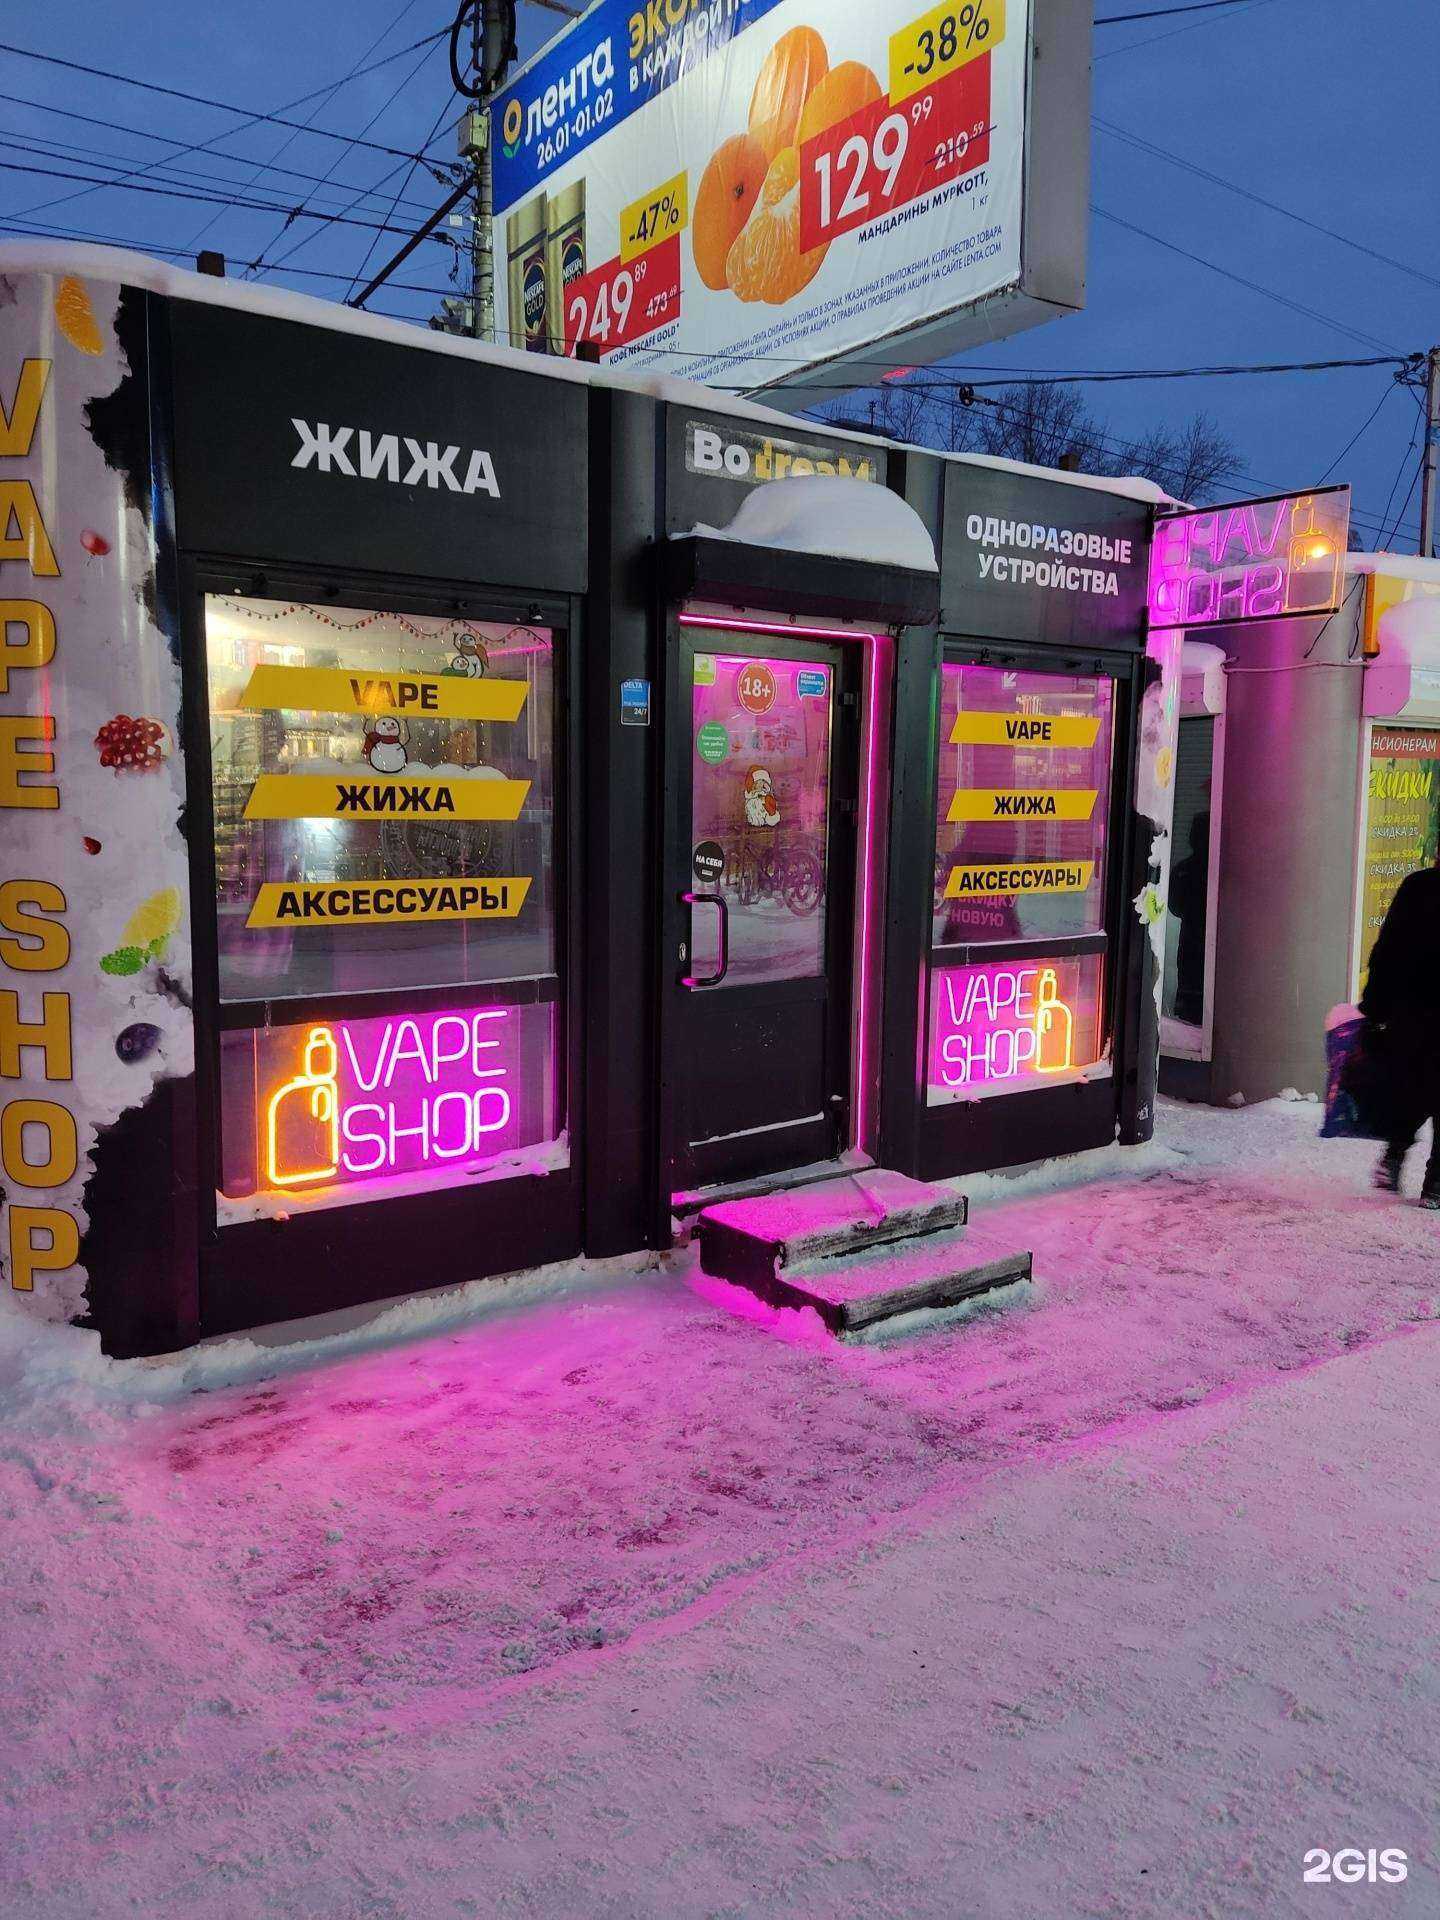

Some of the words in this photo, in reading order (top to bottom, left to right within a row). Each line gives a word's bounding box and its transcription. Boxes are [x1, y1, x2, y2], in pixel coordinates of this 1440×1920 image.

[629, 0, 698, 59] ЭКО
[904, 0, 990, 75] -38%
[525, 37, 615, 146] лента
[630, 66, 639, 93] В
[537, 88, 613, 169] 26.01-01.02
[815, 113, 909, 229] 129
[629, 190, 679, 242] -47%
[858, 199, 930, 245] МАНДАРИНЫ
[932, 171, 989, 209] МУРКОТТ,
[931, 235, 975, 264] КОЛИЧЕСТВО
[976, 224, 1001, 244] ТОВАРА
[527, 294, 544, 315] GOLD
[569, 270, 634, 358] 249
[836, 299, 866, 322] ПРАВИЛАХ
[867, 281, 906, 308] ПРОВЕДЕНИЯ
[941, 255, 963, 276] САЙТЕ
[290, 418, 501, 498] ЖИЖА
[966, 514, 1132, 564] ОДНОРАЗОВЫЕ
[978, 552, 1119, 596] УСТРОЙСТВА
[350, 679, 439, 710] VAPE
[743, 677, 771, 698] 18+
[1005, 720, 1052, 741] VAPE
[335, 785, 455, 812] ЖИЖА
[993, 796, 1056, 815] ЖИЖА
[276, 886, 508, 919] АКСЕССУАРЫ
[959, 867, 1082, 891] АКСЕССУАРЫ
[951, 908, 1005, 928] НОВУЮ
[946, 970, 1038, 1026] VAPE
[343, 1011, 508, 1091] VAPE
[941, 1027, 1036, 1086] SHOP
[0, 879, 80, 1291] SHOP
[342, 1087, 510, 1172] SHOP
